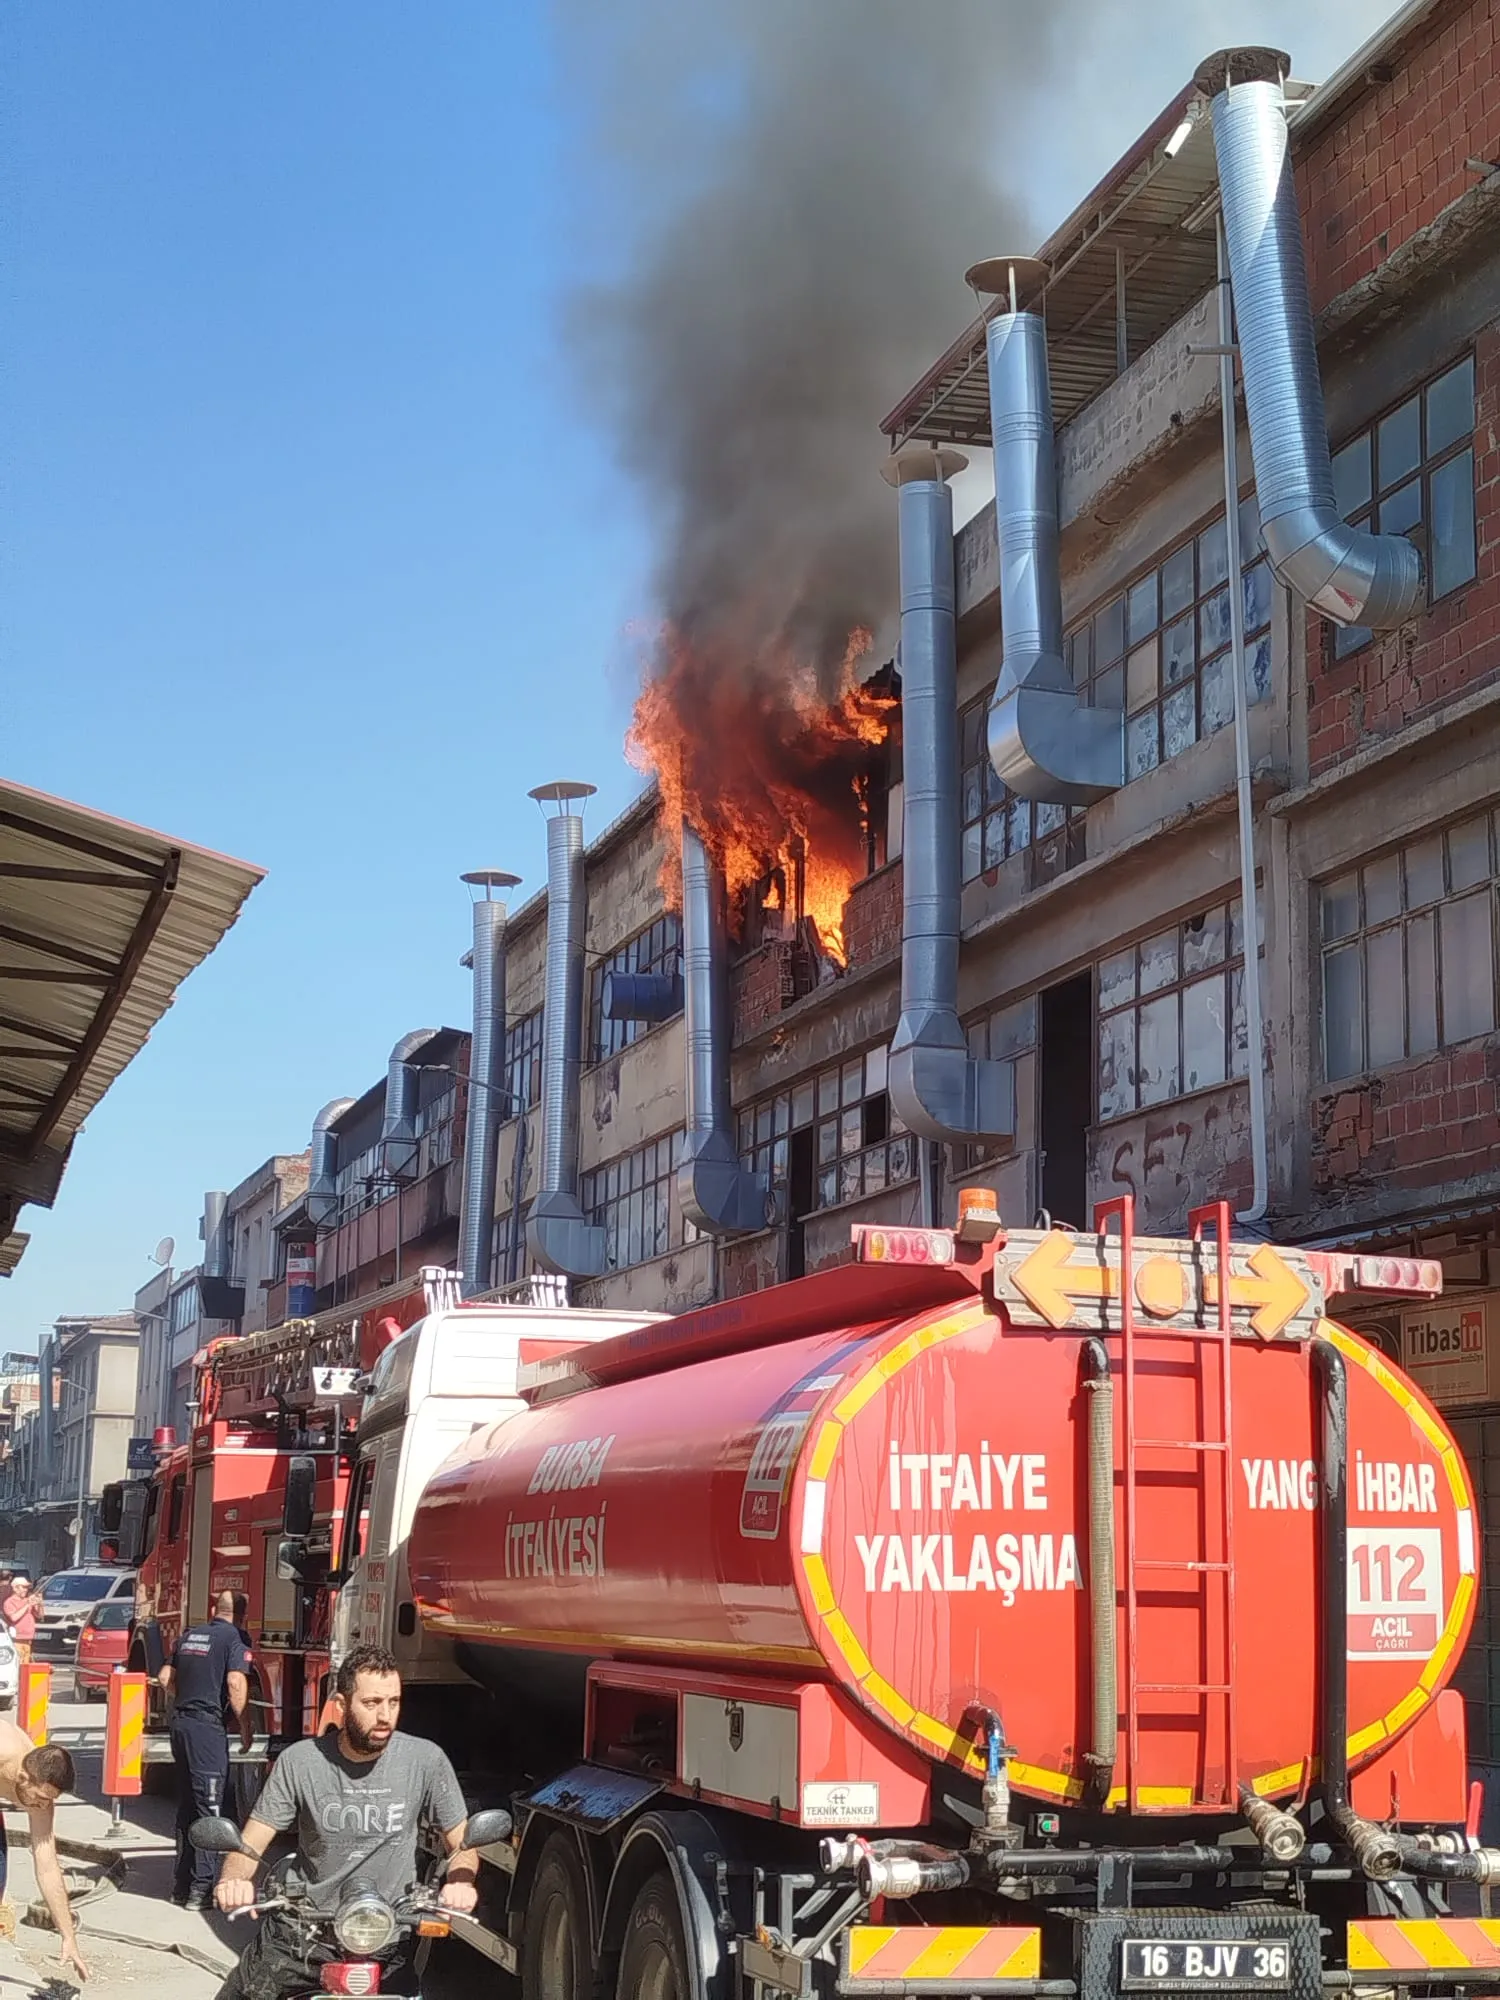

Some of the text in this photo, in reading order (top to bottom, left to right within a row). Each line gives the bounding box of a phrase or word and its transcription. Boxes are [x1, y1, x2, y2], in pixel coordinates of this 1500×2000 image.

[1407, 1316, 1482, 1355] Tibasin
[526, 1434, 616, 1495] BURSA
[754, 1425, 794, 1480] 112
[889, 1440, 1048, 1510] İTFAİYE
[1241, 1450, 1437, 1512] YANG İHBAR
[505, 1500, 607, 1578] İTFAİYESİ
[854, 1534, 1084, 1607] YAKLAŞMA
[1352, 1544, 1426, 1602] 112
[1376, 1638, 1409, 1651] ÇAĞRI
[806, 1805, 874, 1816] TEKNİK TANKER
[1141, 1946, 1285, 1978] 16 BJV 36
